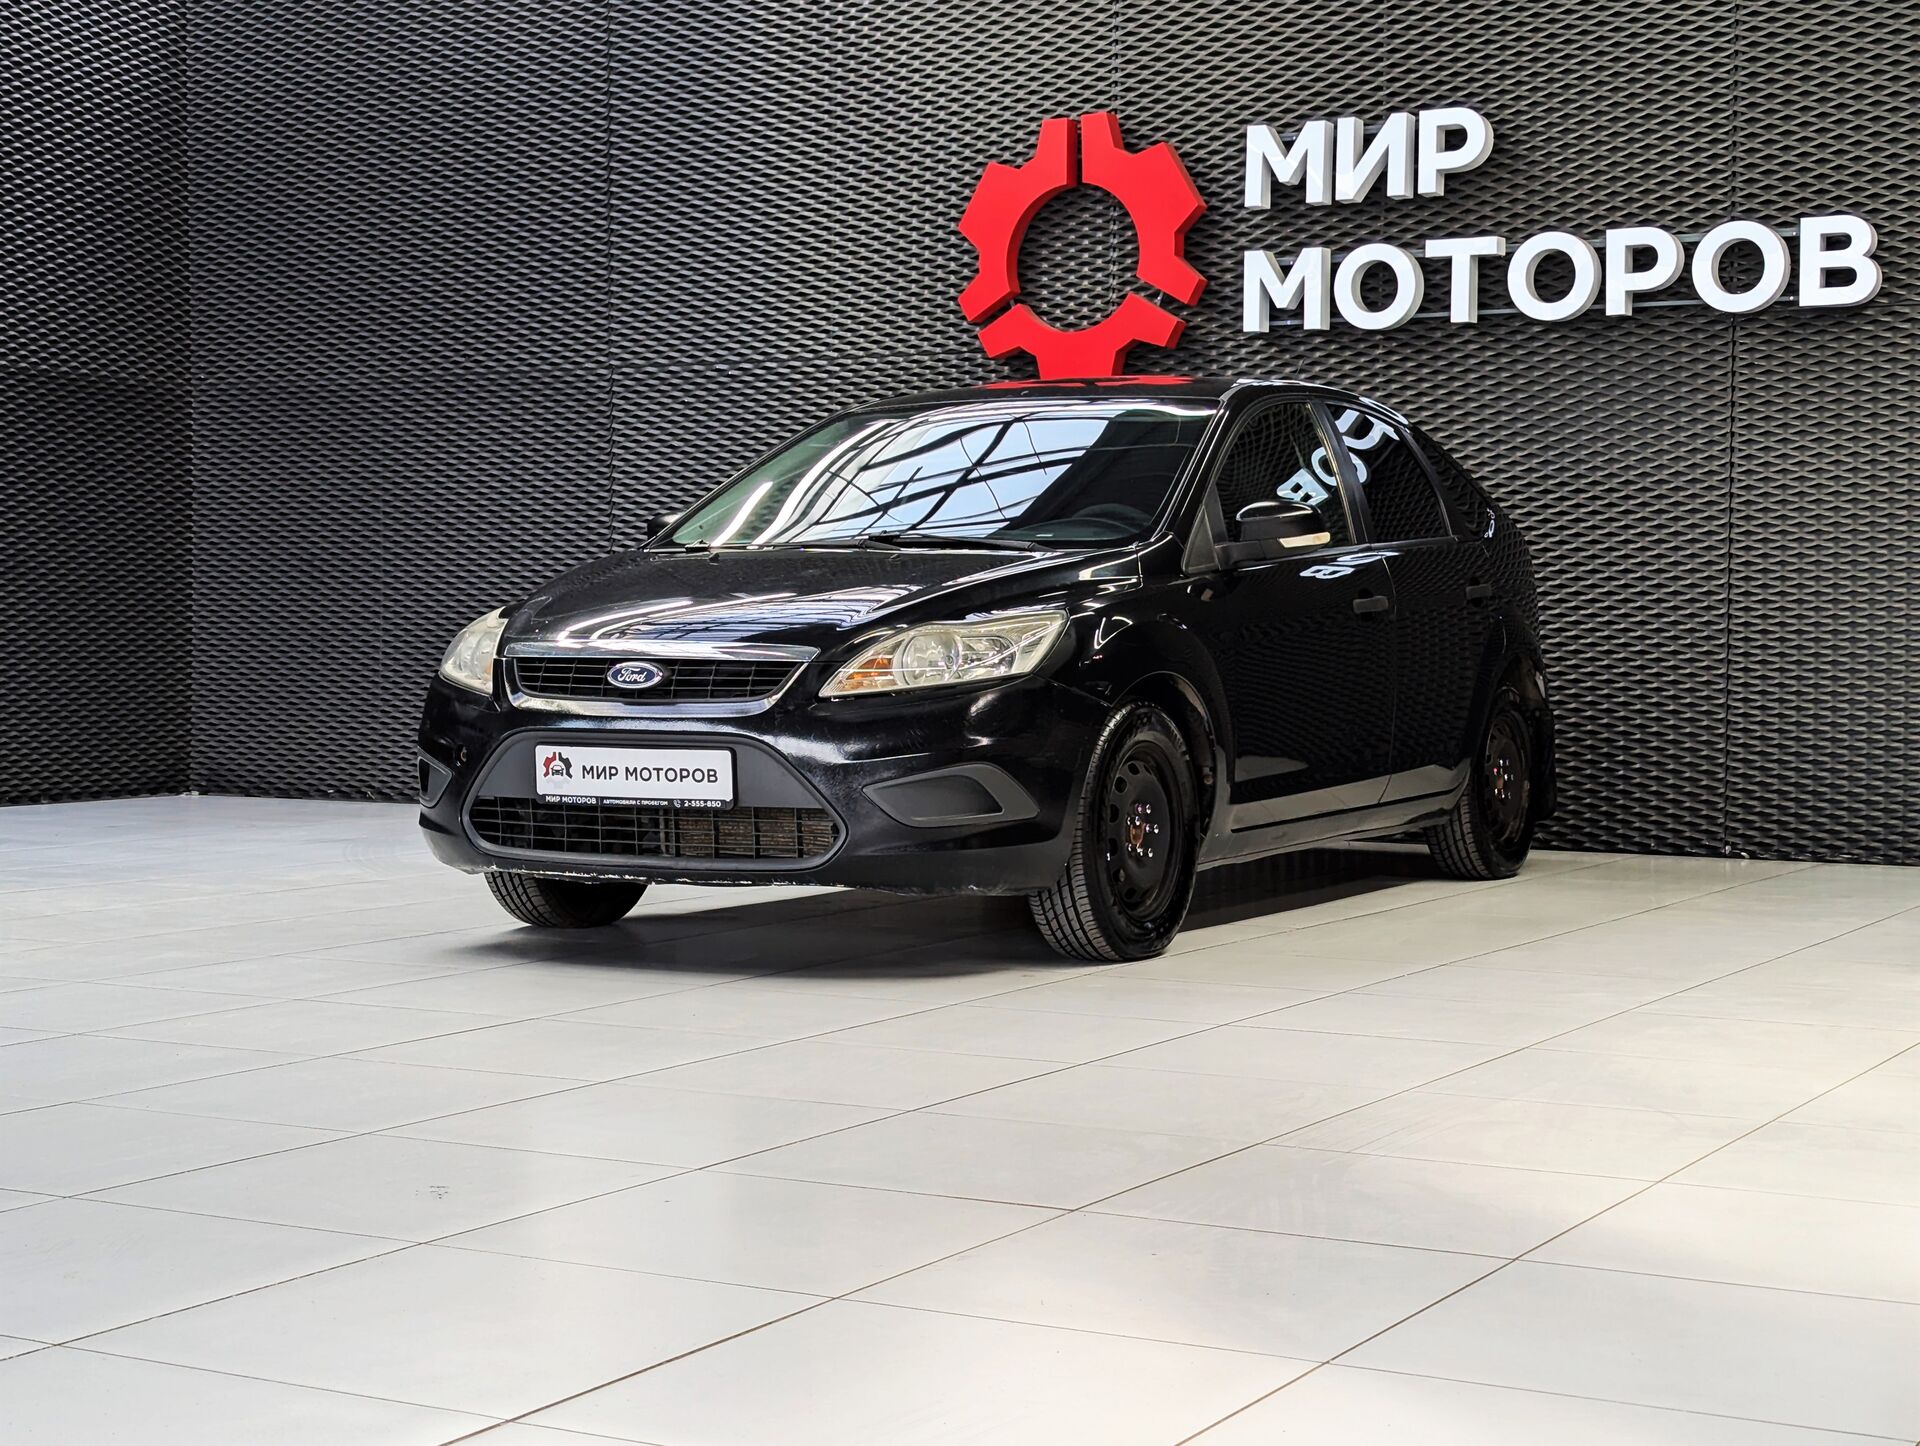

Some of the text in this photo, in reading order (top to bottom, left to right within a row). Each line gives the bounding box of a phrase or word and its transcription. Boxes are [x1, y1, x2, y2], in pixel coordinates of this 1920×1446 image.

[1243, 106, 1494, 210] МИР
[1242, 214, 1882, 333] МОТОРОВ
[617, 667, 646, 682] Ford
[582, 765, 718, 783] МИР МОТОРОВ
[545, 795, 596, 804] МИР МОТОРОВ
[684, 800, 722, 808] 2-555-850
